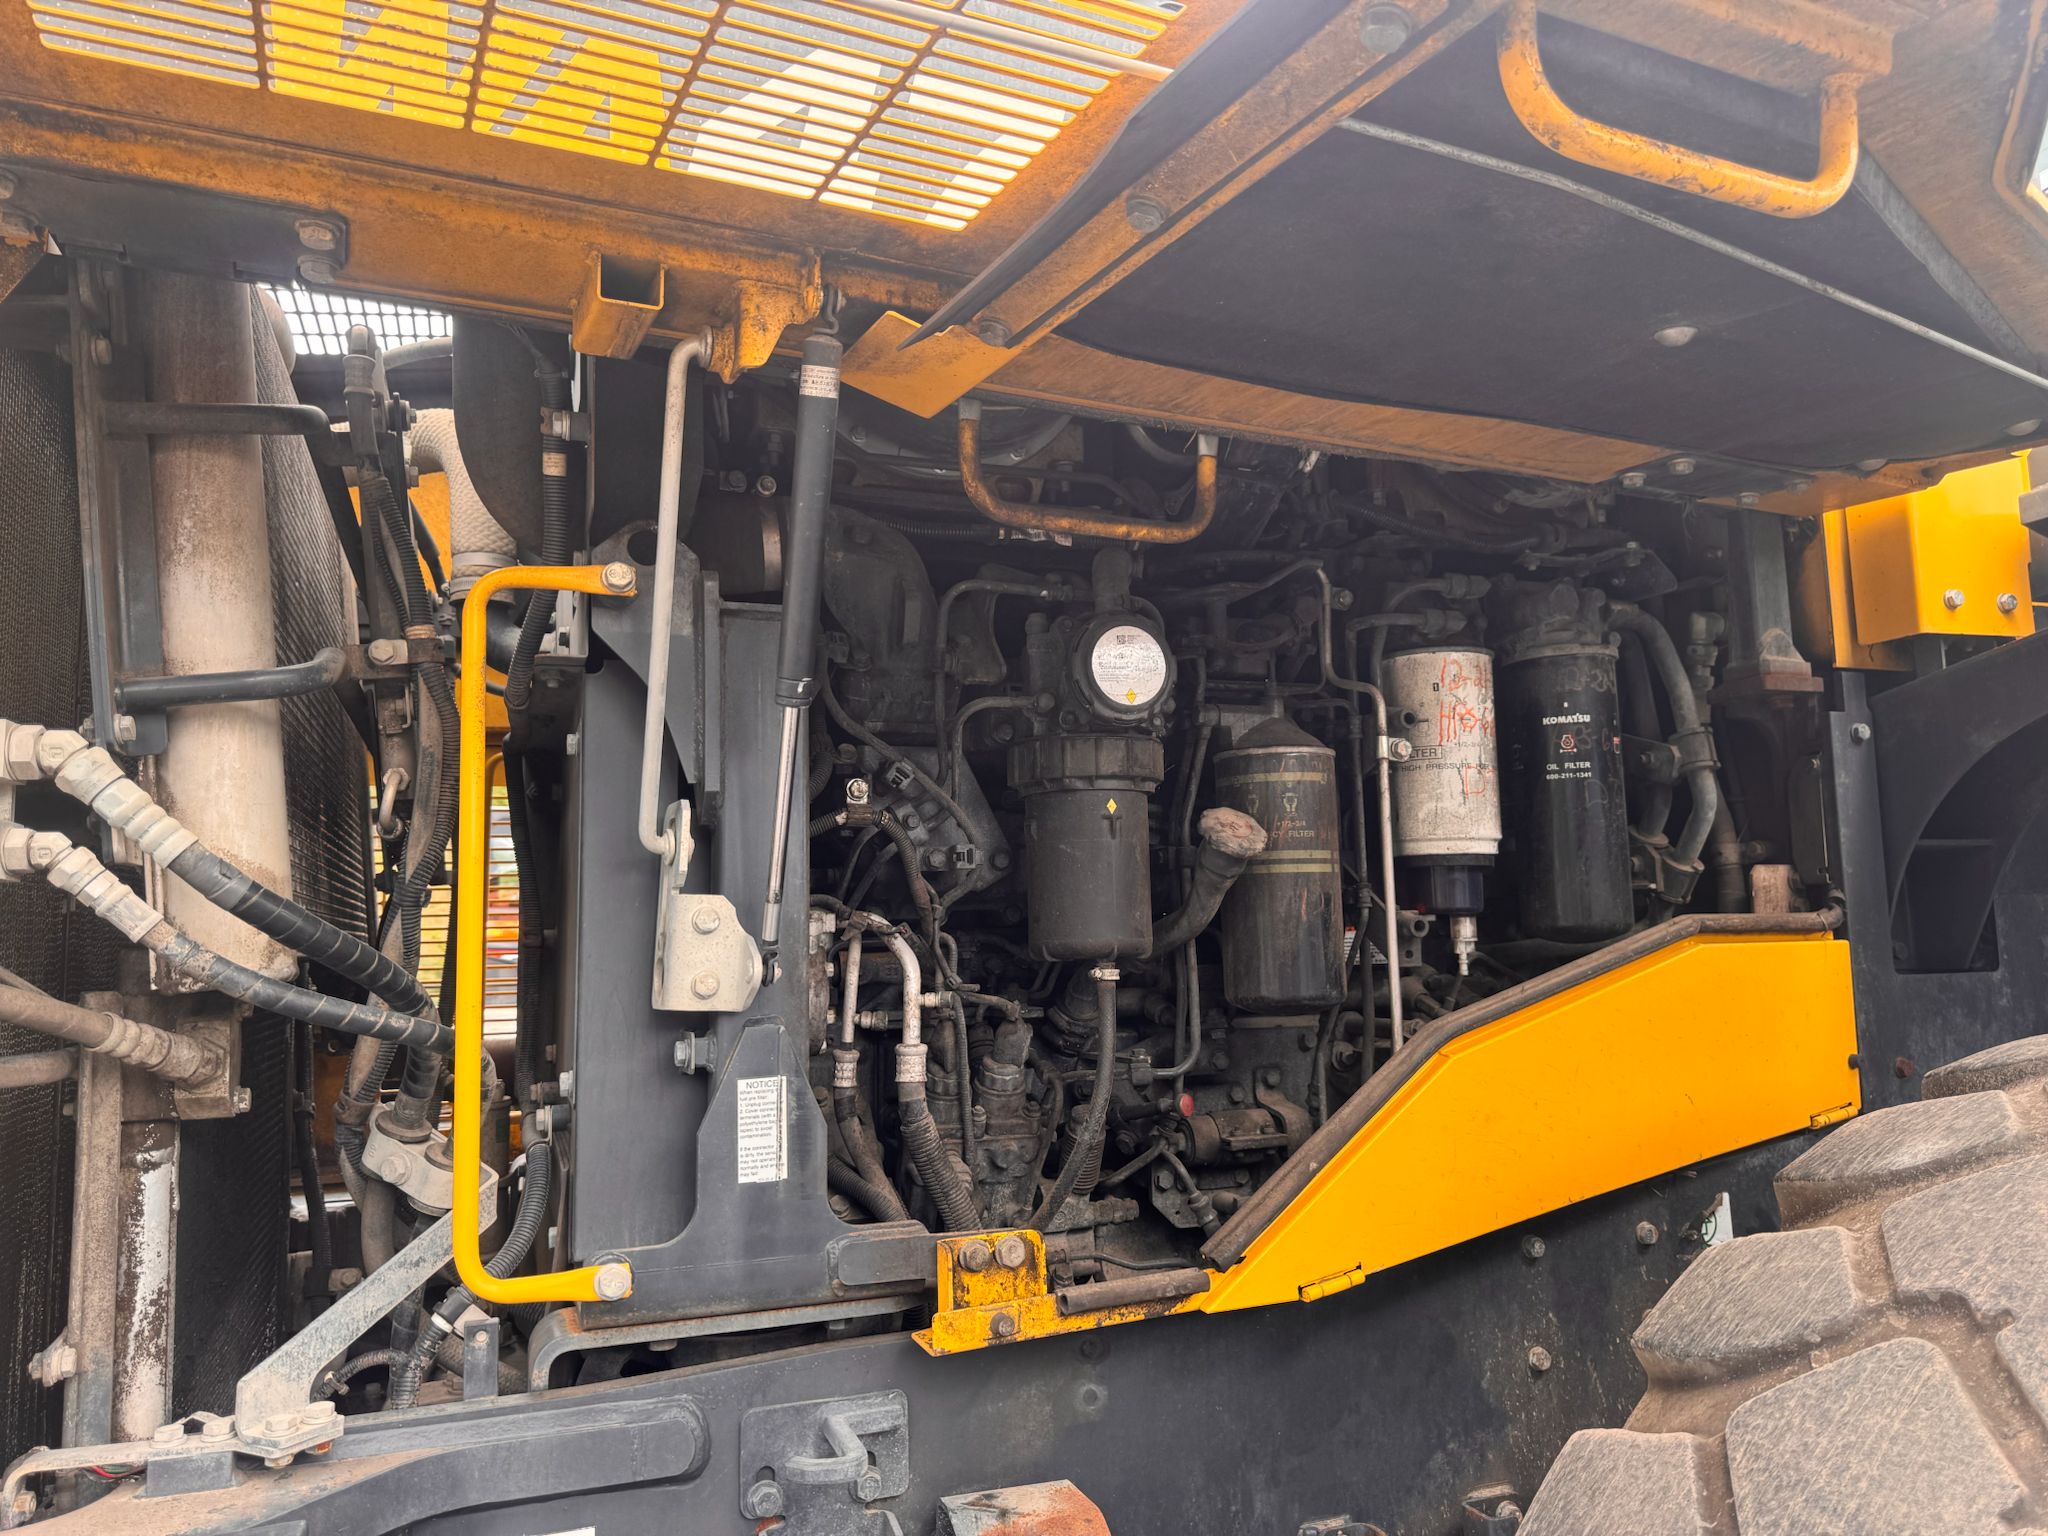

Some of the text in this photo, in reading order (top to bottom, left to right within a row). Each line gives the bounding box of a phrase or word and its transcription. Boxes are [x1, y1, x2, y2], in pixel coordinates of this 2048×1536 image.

[1542, 712, 1591, 725] KOMATSU
[1401, 764, 1421, 773] HIGH
[1425, 762, 1472, 770] PRESSURE
[1546, 761, 1591, 771] OIL FILTER
[1288, 830, 1314, 838] FILTER
[746, 1079, 779, 1090] NOTICE
